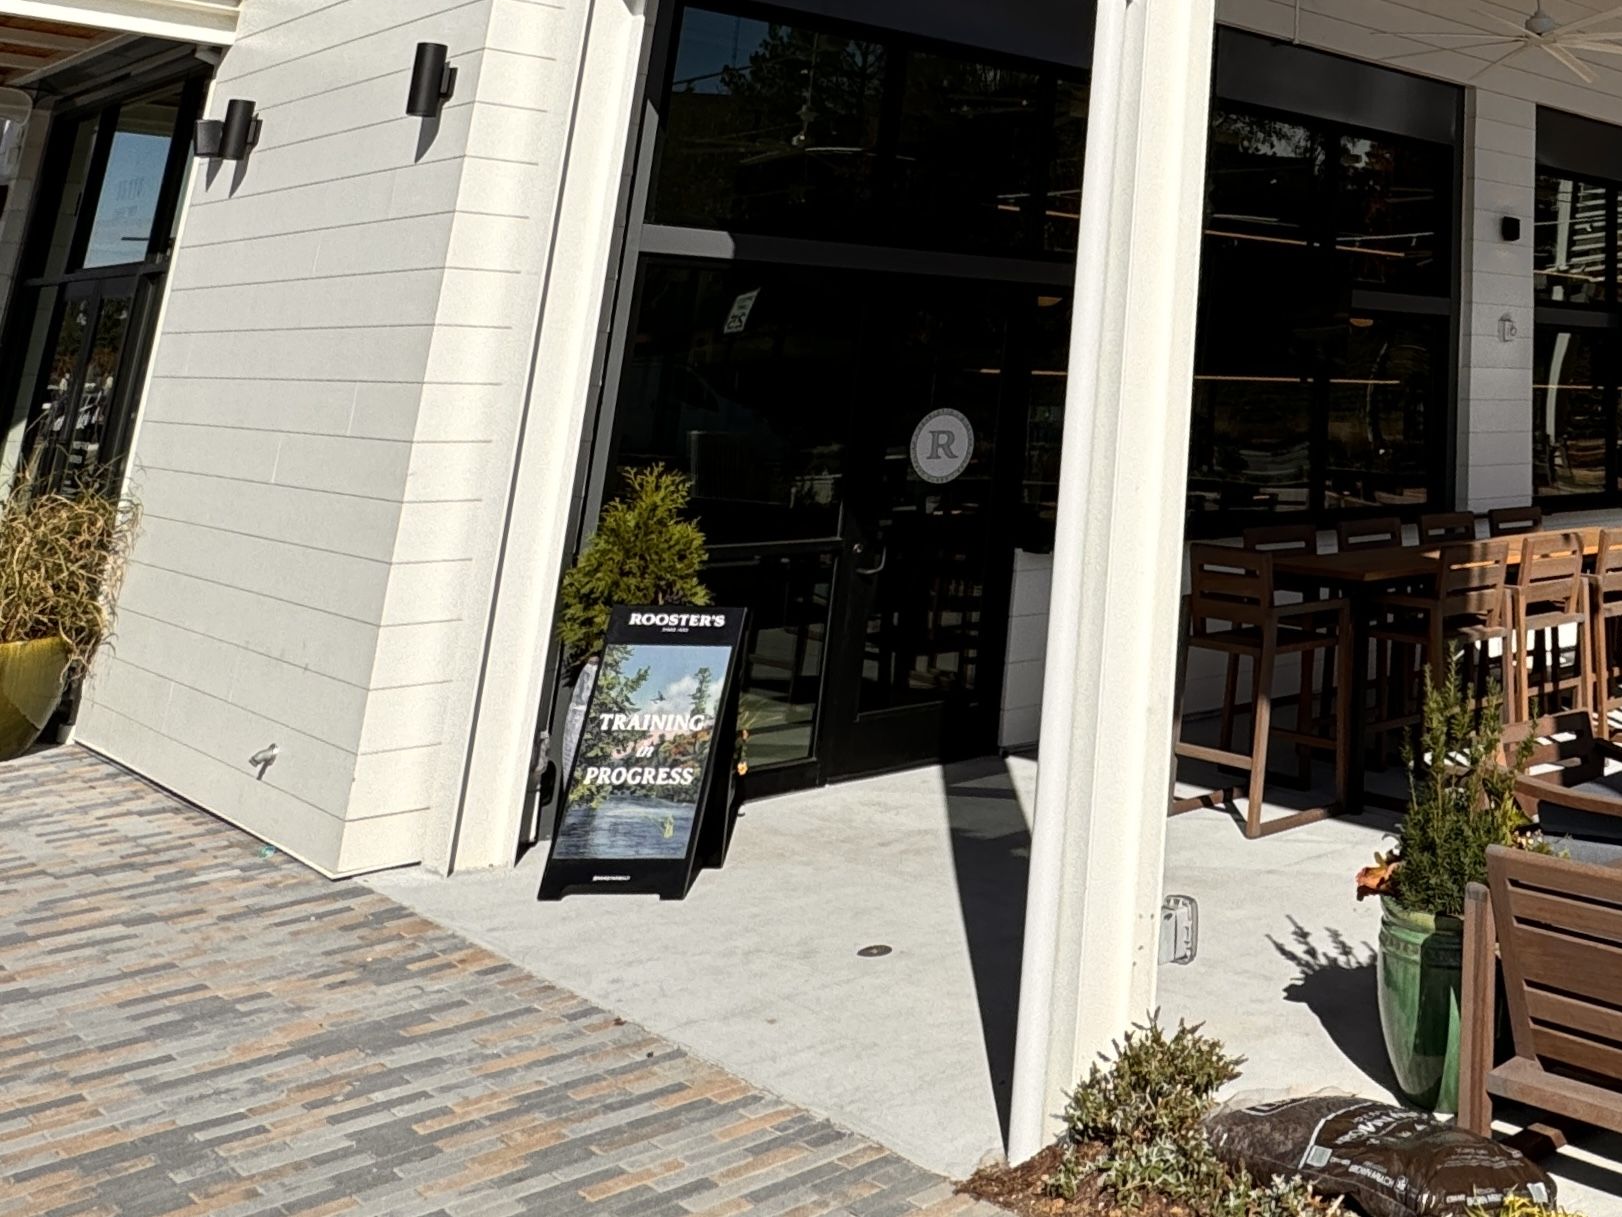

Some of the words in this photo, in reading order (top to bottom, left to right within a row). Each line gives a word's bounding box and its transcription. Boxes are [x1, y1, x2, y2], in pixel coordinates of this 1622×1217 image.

[926, 430, 959, 460] R
[628, 612, 726, 628] ROOSTER'S
[600, 713, 704, 731] TRAINING
[635, 744, 655, 758] in
[583, 767, 694, 785] PROGRESS
